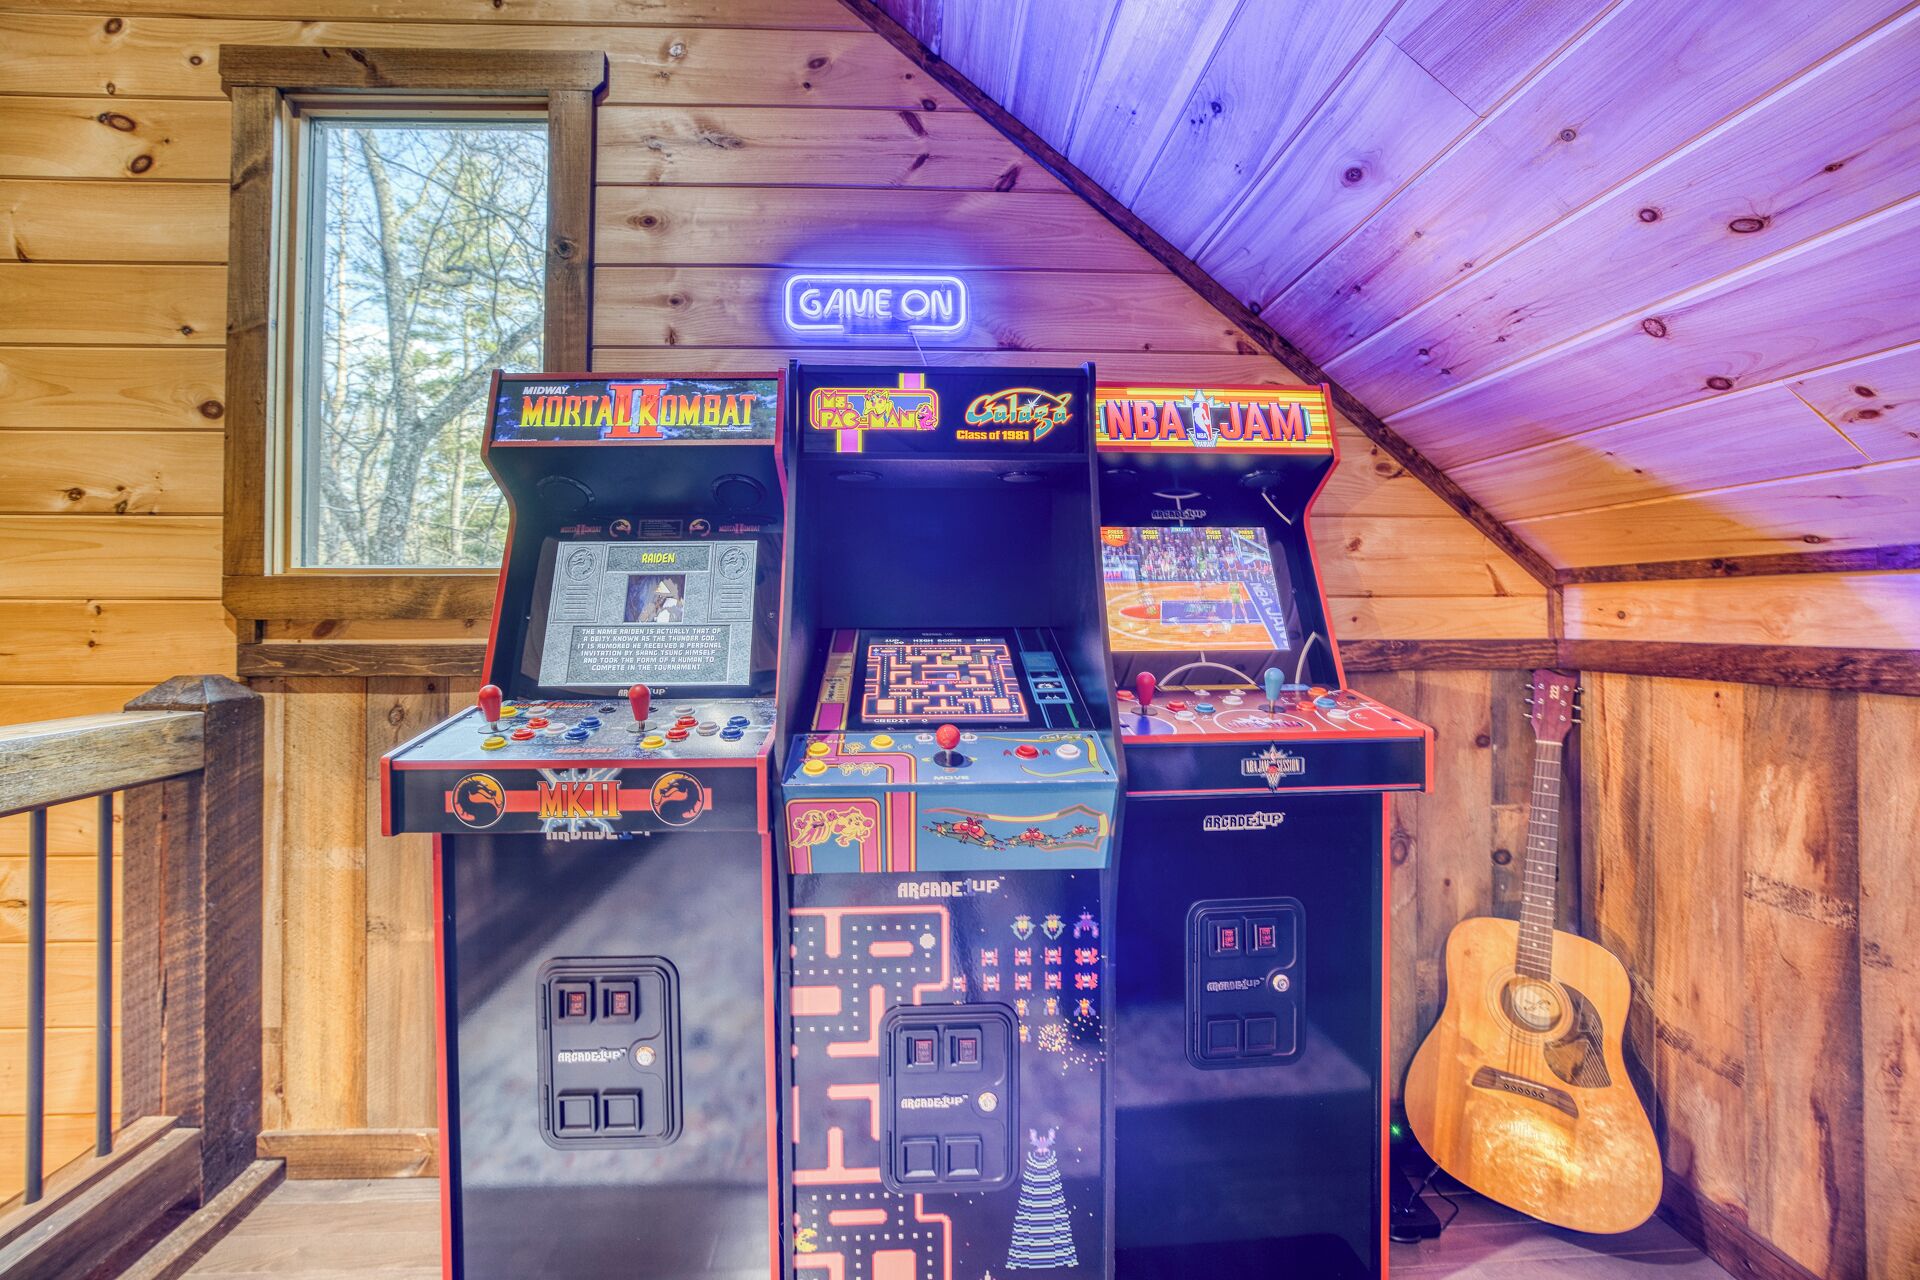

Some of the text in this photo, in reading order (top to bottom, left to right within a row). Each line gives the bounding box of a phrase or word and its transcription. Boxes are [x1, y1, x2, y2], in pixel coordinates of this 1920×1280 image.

[799, 288, 952, 319] GAME ON
[522, 386, 568, 395] MIDWAY
[965, 388, 1072, 441] Galaga
[1105, 400, 1306, 441] NBA JAM
[956, 430, 1029, 440] Class of 1981
[641, 552, 676, 564] RAIDEN
